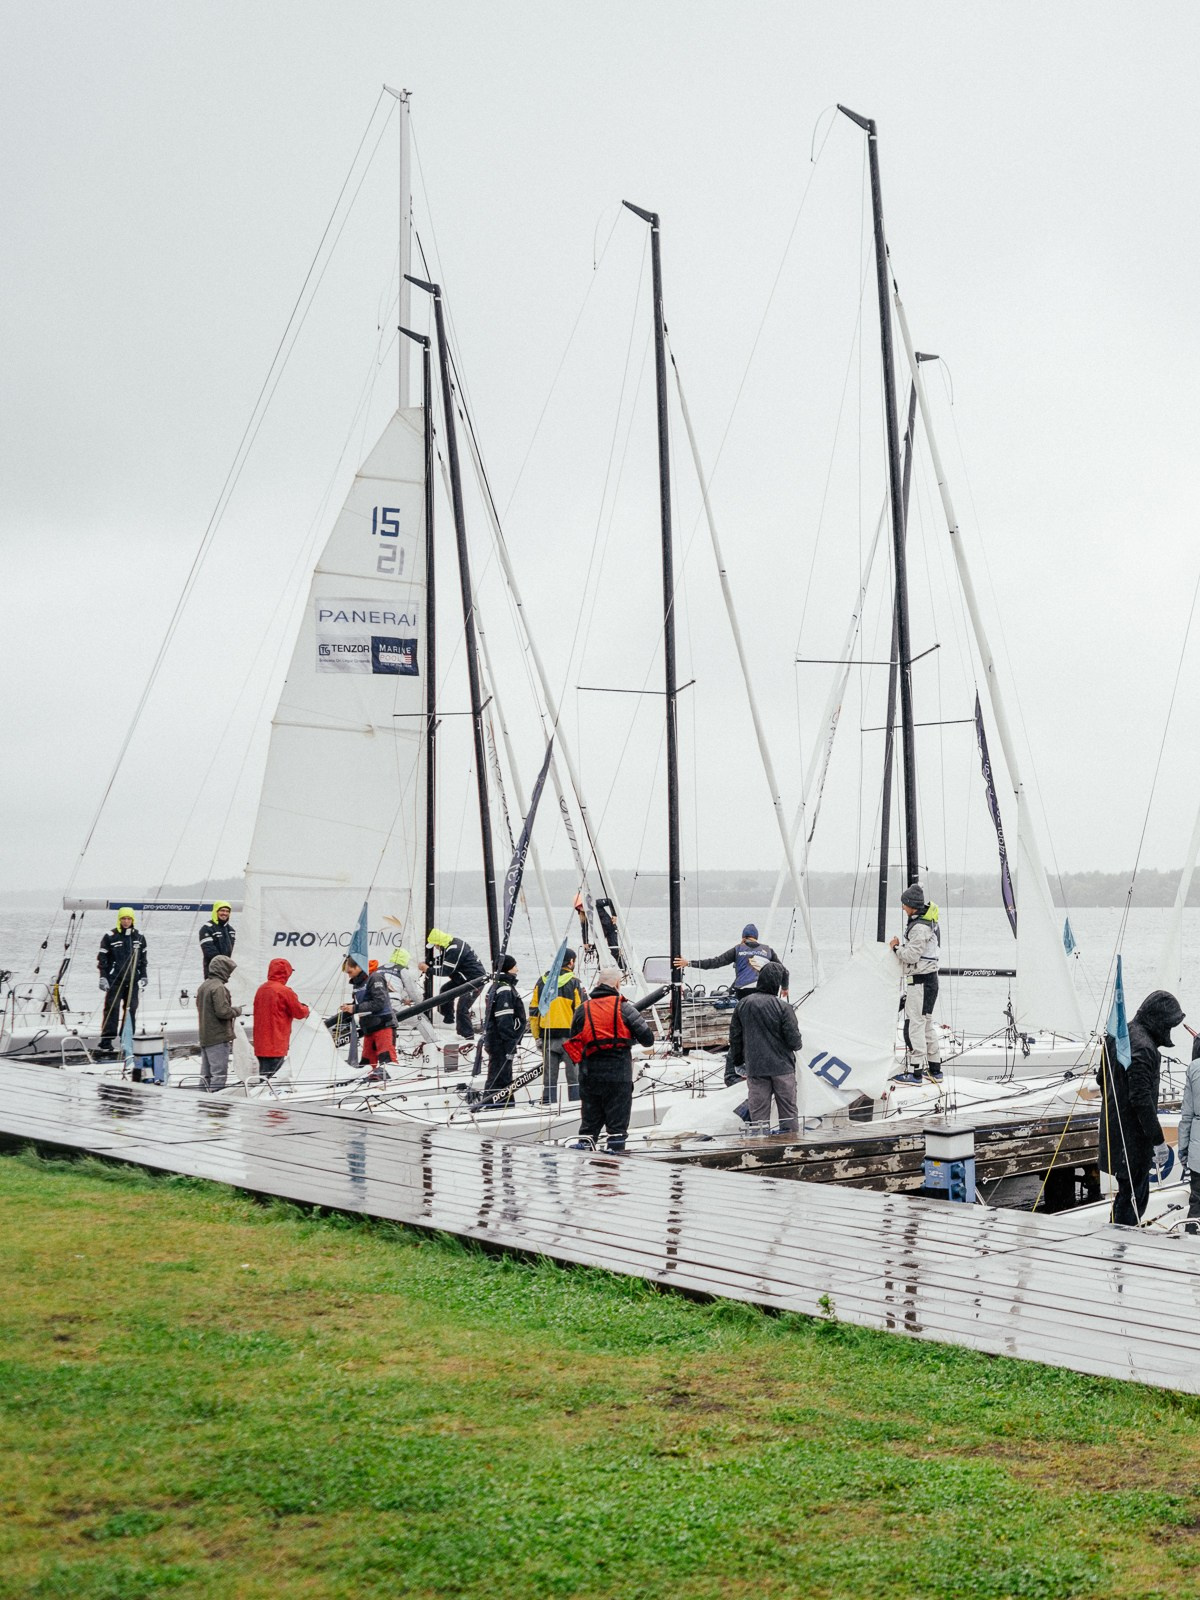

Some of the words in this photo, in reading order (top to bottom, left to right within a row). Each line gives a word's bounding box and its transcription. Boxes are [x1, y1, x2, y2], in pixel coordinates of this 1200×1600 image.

[372, 506, 400, 537] 15
[319, 609, 416, 627] PANERAI
[332, 644, 370, 653] TENZOR
[379, 644, 412, 655] MARINE
[273, 931, 403, 948] PROYACTING
[492, 1065, 544, 1104] pro-yachting.r
